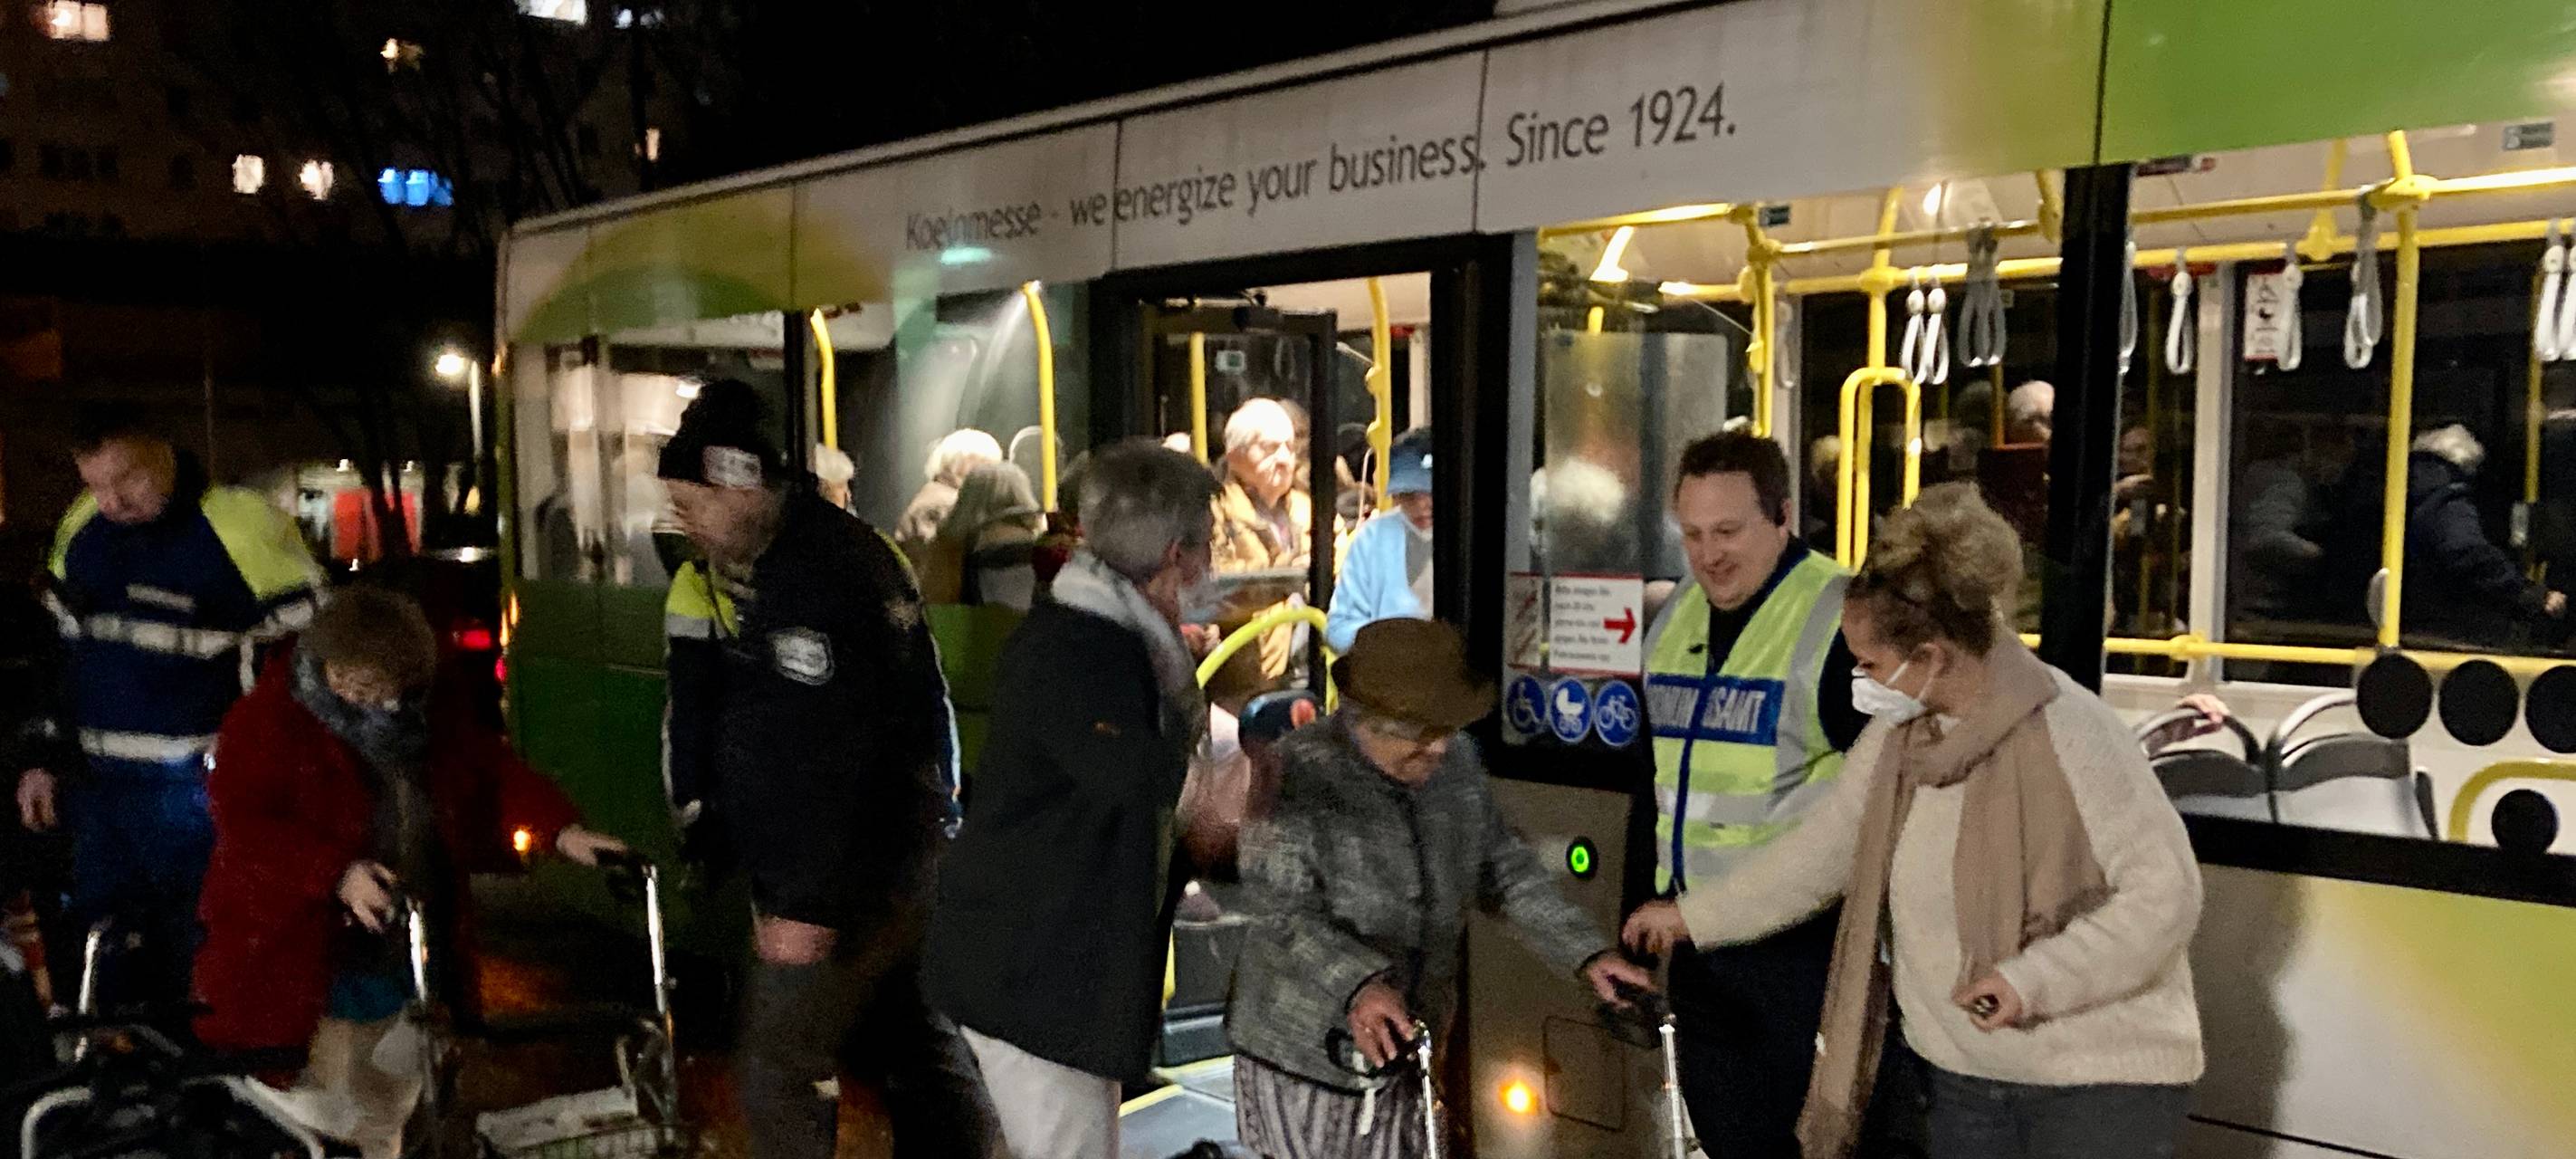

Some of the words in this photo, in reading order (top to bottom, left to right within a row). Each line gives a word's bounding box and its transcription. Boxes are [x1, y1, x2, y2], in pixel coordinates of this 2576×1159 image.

[1070, 192, 1107, 226] we
[1114, 164, 1237, 225] energize
[1246, 157, 1319, 217] your
[1329, 134, 1486, 193] business.
[1505, 111, 1609, 167] Since
[1629, 80, 1735, 148] 1924.
